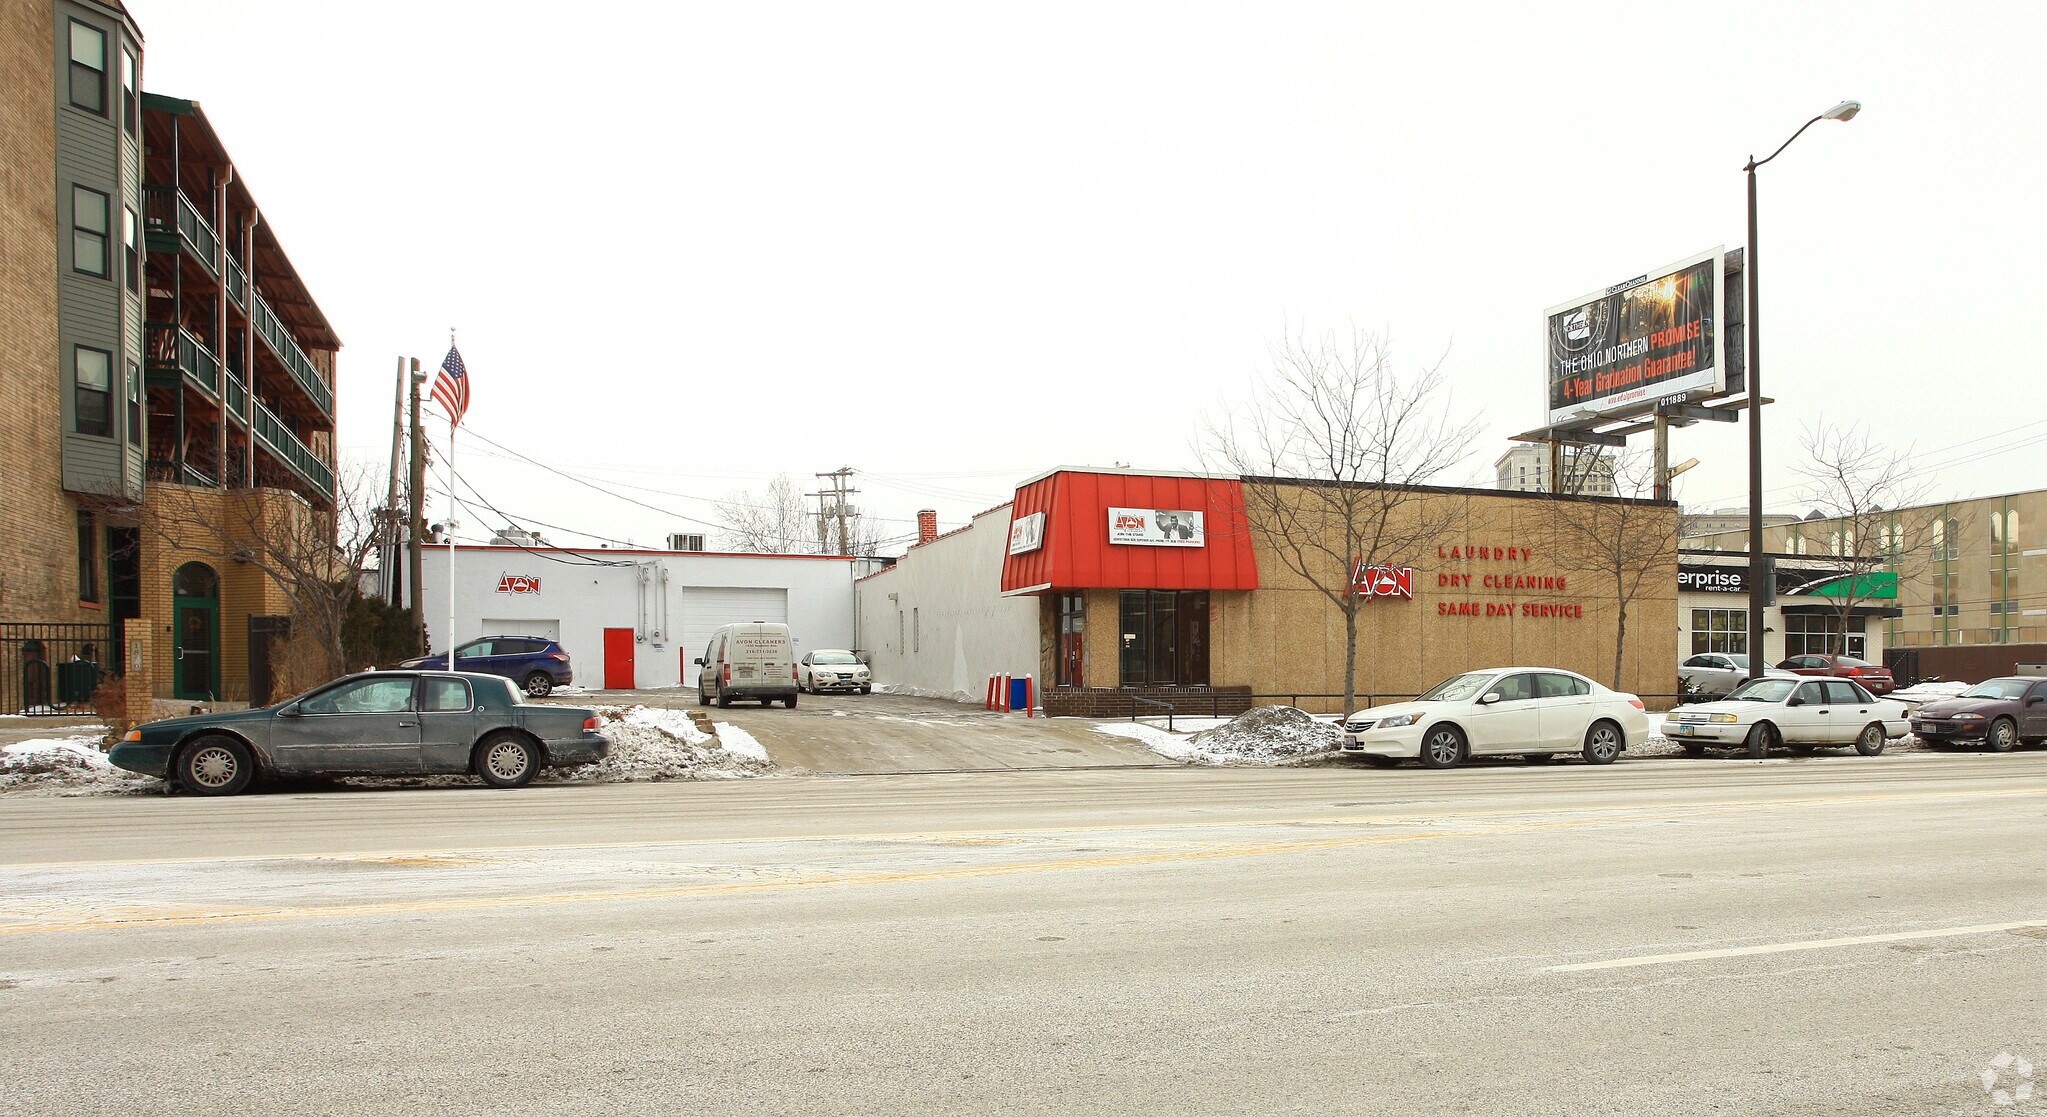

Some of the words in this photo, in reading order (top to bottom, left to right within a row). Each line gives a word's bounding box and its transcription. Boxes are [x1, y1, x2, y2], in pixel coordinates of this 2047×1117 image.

[1560, 357, 1579, 376] THE
[1580, 350, 1602, 371] OHIO
[1605, 336, 1649, 365] NORTHERN
[1650, 320, 1700, 350] PROMISE
[1563, 377, 1593, 399] 4-Year
[1595, 364, 1642, 392] Graduation
[1644, 344, 1696, 378] Guarantee!
[1660, 393, 1687, 406] 011889
[1114, 511, 1146, 531] AVON
[1438, 546, 1532, 561] LAUNDRY
[494, 570, 542, 597] AVON
[1347, 557, 1413, 602] AVON
[1438, 573, 1473, 588] DRY
[1483, 574, 1567, 590] CLEANING
[1438, 601, 1481, 616] SAME
[1486, 603, 1517, 616] DAY
[1522, 603, 1583, 618] SERVICE
